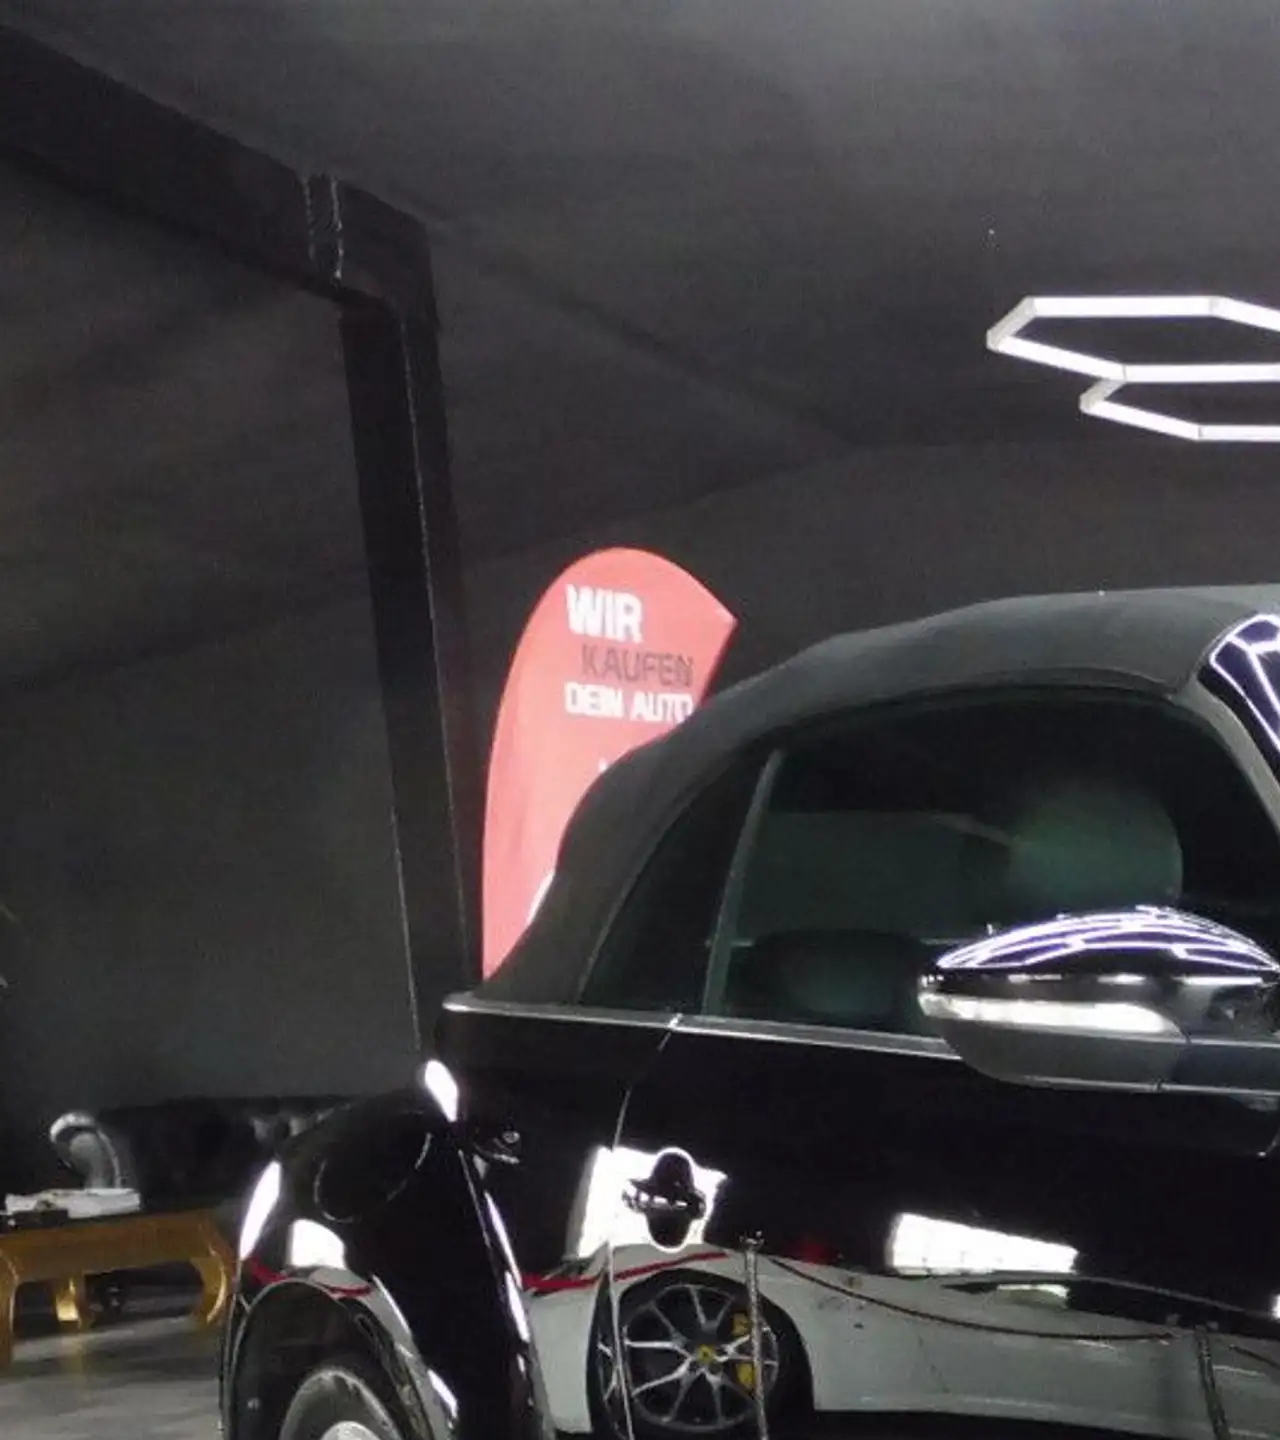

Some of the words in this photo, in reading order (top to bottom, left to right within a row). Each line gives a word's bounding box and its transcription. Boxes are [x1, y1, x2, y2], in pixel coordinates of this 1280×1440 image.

[566, 583, 643, 643] WIR
[581, 644, 694, 687] KAUFEN
[564, 682, 624, 719] DEIN
[630, 691, 692, 723] AUTO
